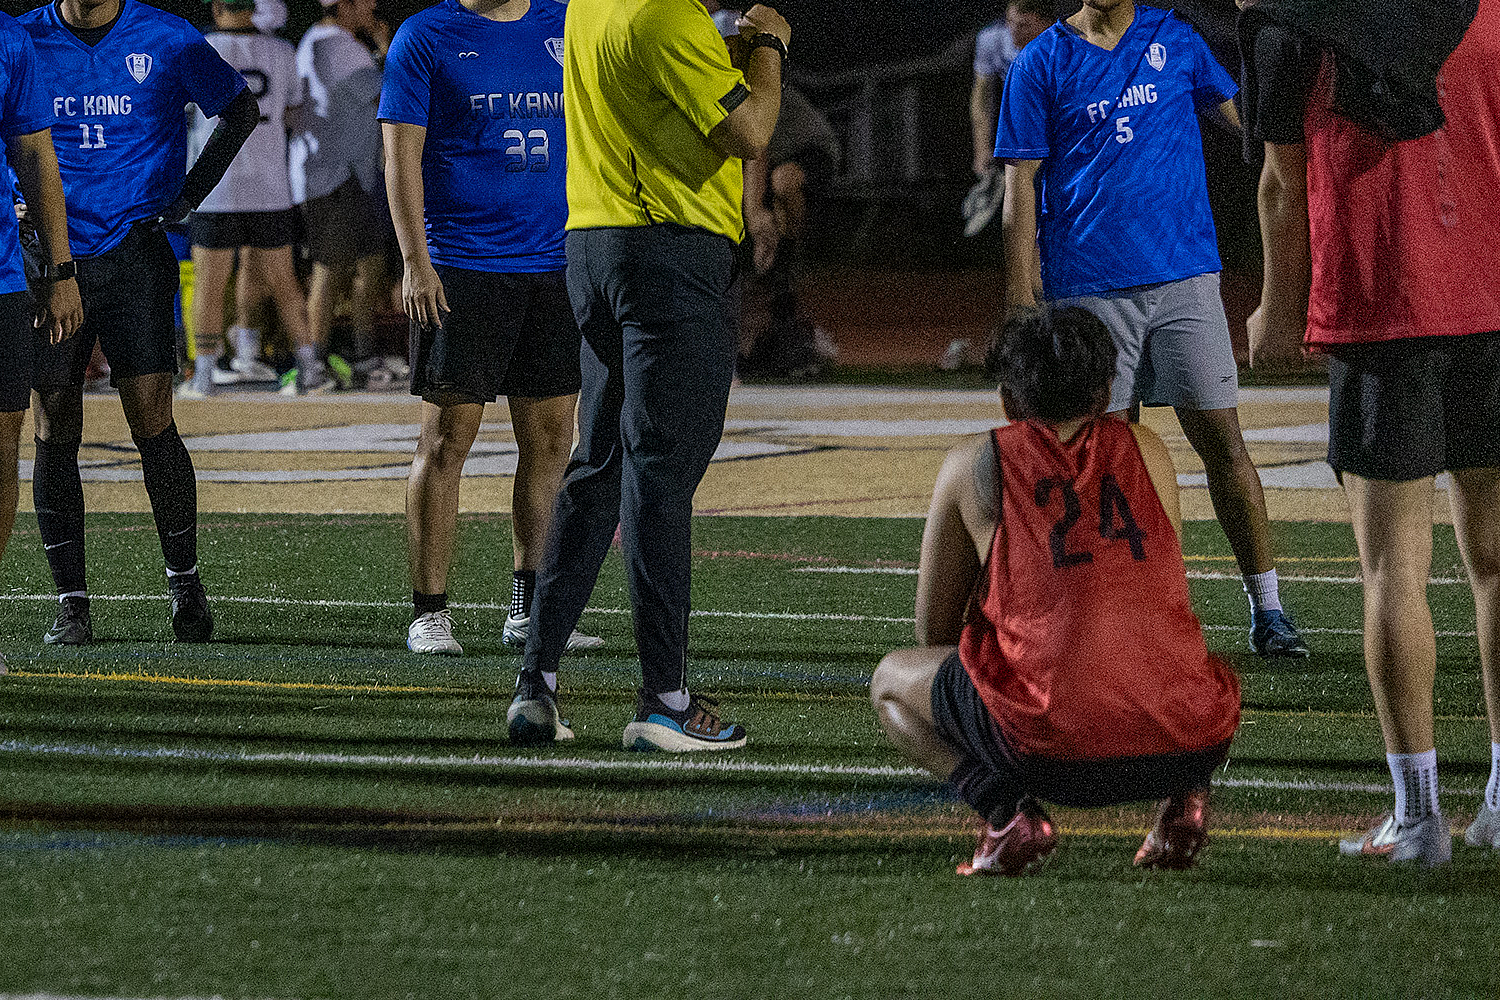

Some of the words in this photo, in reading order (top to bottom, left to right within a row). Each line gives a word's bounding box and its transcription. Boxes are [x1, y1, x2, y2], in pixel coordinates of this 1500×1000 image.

[53, 96, 77, 117] FC
[83, 95, 132, 116] KANG
[469, 93, 505, 119] FC
[508, 92, 564, 119] KAN
[1115, 83, 1158, 109] ANG
[79, 123, 107, 149] 11
[1115, 116, 1134, 144] 5
[503, 129, 550, 172] 33
[1034, 472, 1147, 569] 24
